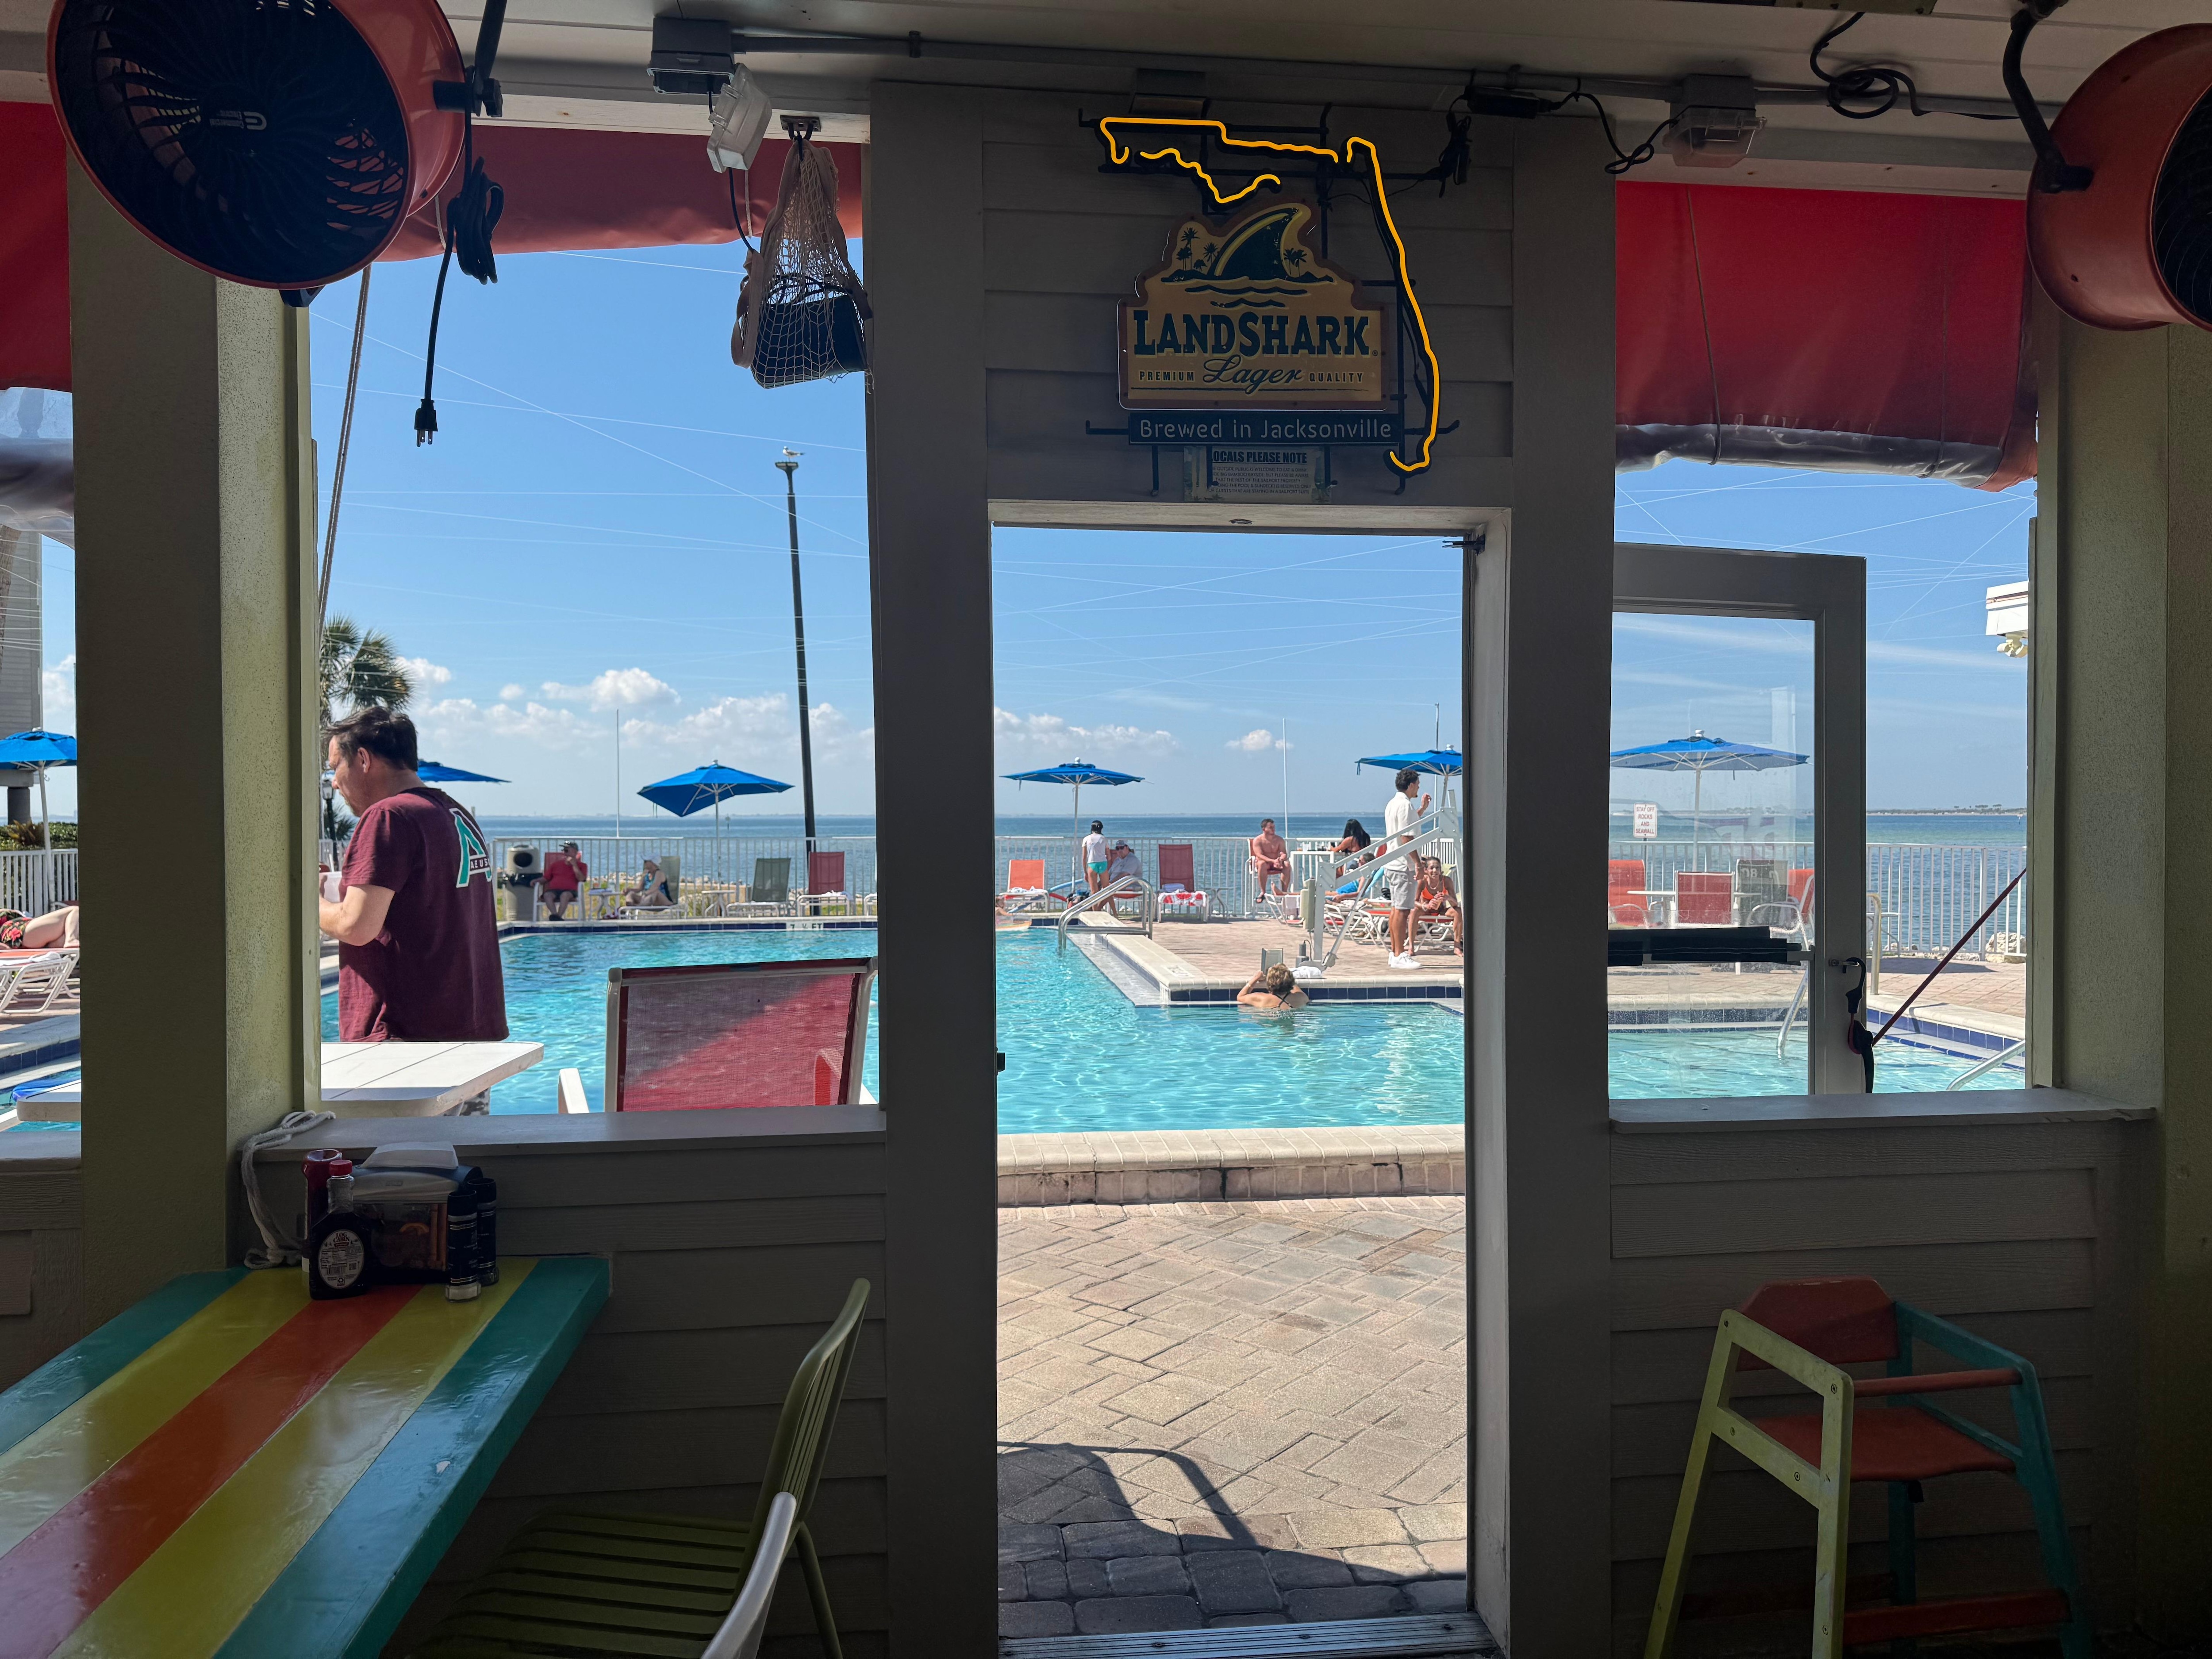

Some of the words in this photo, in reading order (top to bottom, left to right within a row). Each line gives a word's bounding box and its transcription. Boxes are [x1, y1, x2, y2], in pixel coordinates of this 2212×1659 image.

[1140, 371, 1195, 382] PREMIUM
[1203, 354, 1304, 395] Lager
[1309, 372, 1363, 383] QUALITY
[1140, 419, 1222, 438] Brewed
[1234, 420, 1251, 438] in
[1261, 419, 1392, 438] Jacksonville
[1212, 451, 1244, 462] OCALS
[1247, 452, 1280, 462] PLEASE
[1283, 452, 1307, 463] NOTE
